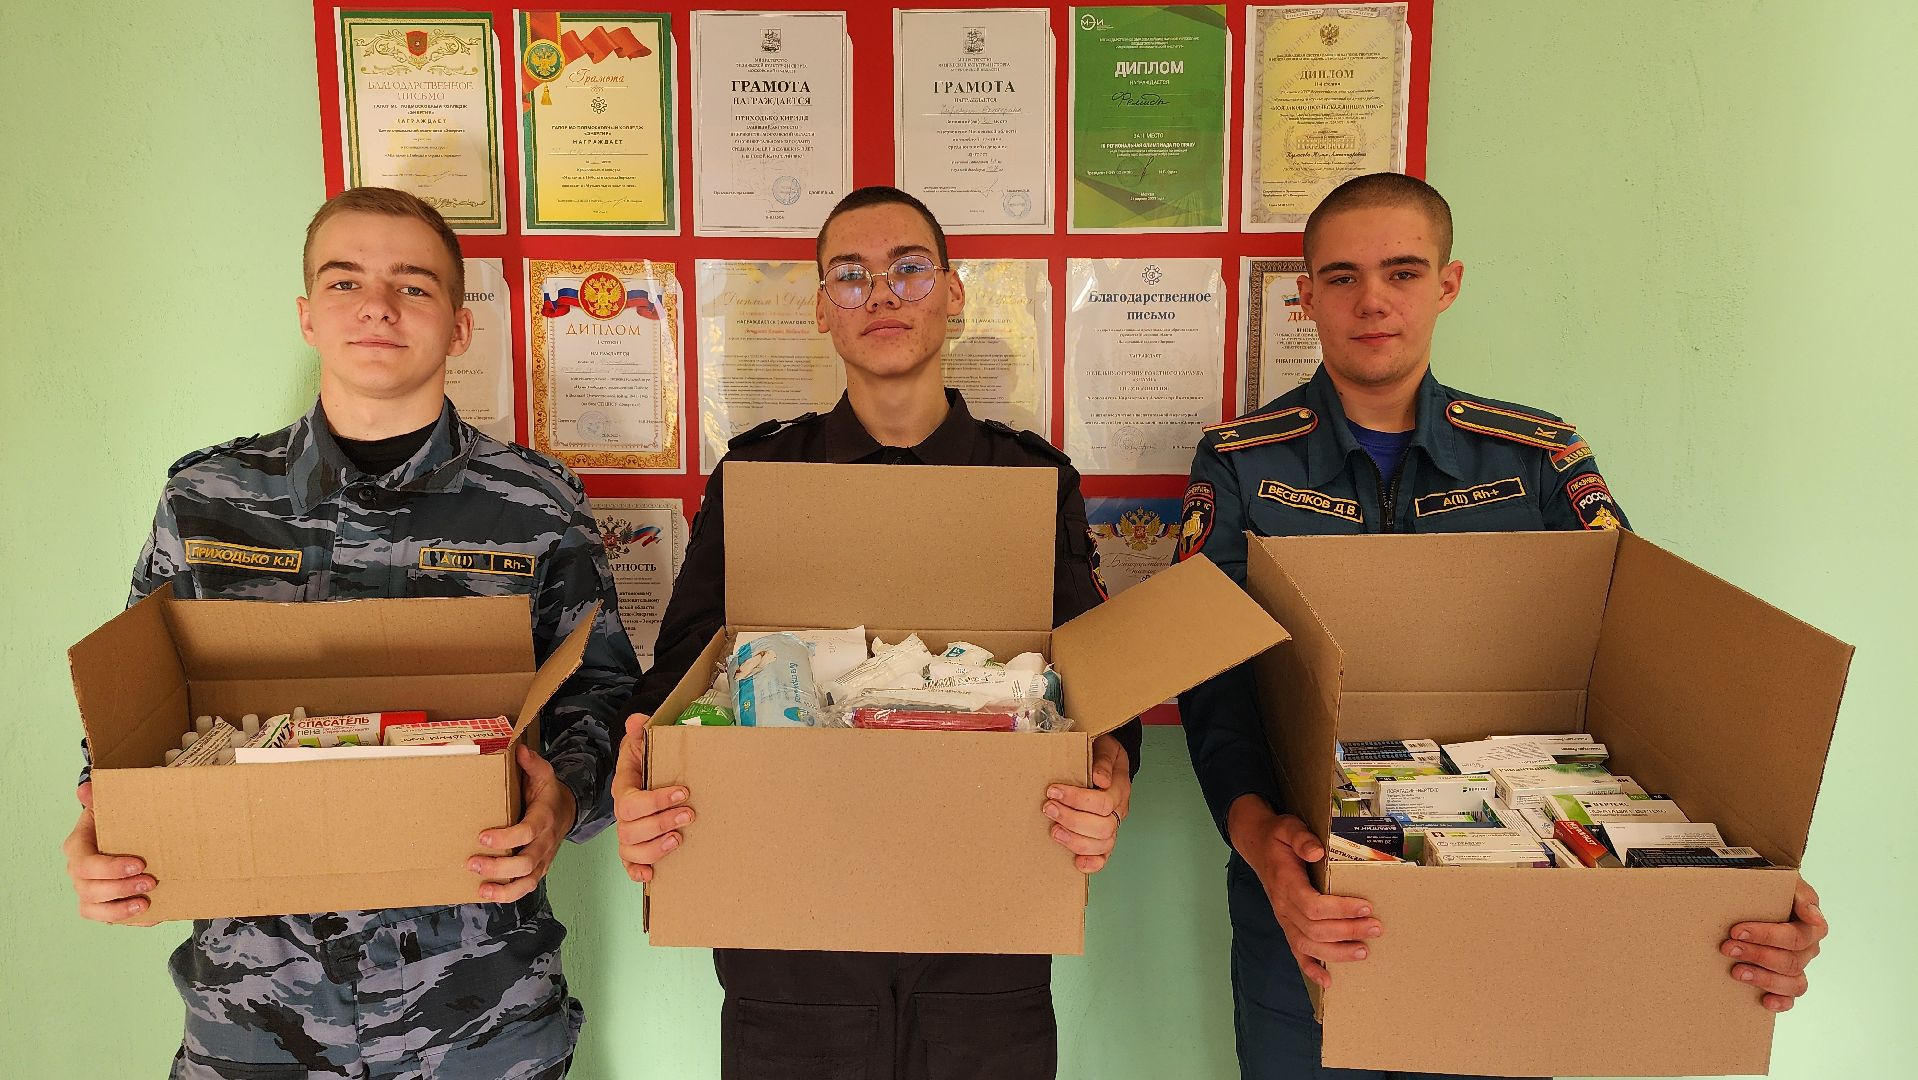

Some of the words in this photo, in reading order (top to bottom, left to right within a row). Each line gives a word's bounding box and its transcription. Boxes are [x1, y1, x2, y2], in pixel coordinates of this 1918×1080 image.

[1080, 14, 1104, 31] МЭИ
[1114, 60, 1185, 78] ДИПЛОМ
[1299, 69, 1354, 80] ДИПЛОМ
[568, 68, 625, 86] Грамота
[367, 81, 474, 91] БЛАГОДАРСТВЕННОЕ
[731, 80, 811, 93] ГРАМОТА
[933, 80, 1015, 94] ГРАМОТА
[397, 92, 446, 101] ПИСЬМО
[733, 97, 811, 106] НАГРАЖДАЕТСЯ
[1087, 291, 1211, 306] Благодарственное
[1127, 310, 1176, 321] письмо
[565, 323, 641, 336] ДИПЛОМ
[1268, 485, 1331, 509] ВЕСЕЛКОВ
[1333, 503, 1358, 517] Д.В.
[1472, 488, 1500, 501] Rh+
[191, 546, 270, 565] ПРИХОДЬКО
[273, 556, 297, 568] К.Н.
[503, 558, 526, 570] Rh-
[297, 716, 370, 729] СПАСАТЕЛЬ
[297, 728, 320, 737] пена
